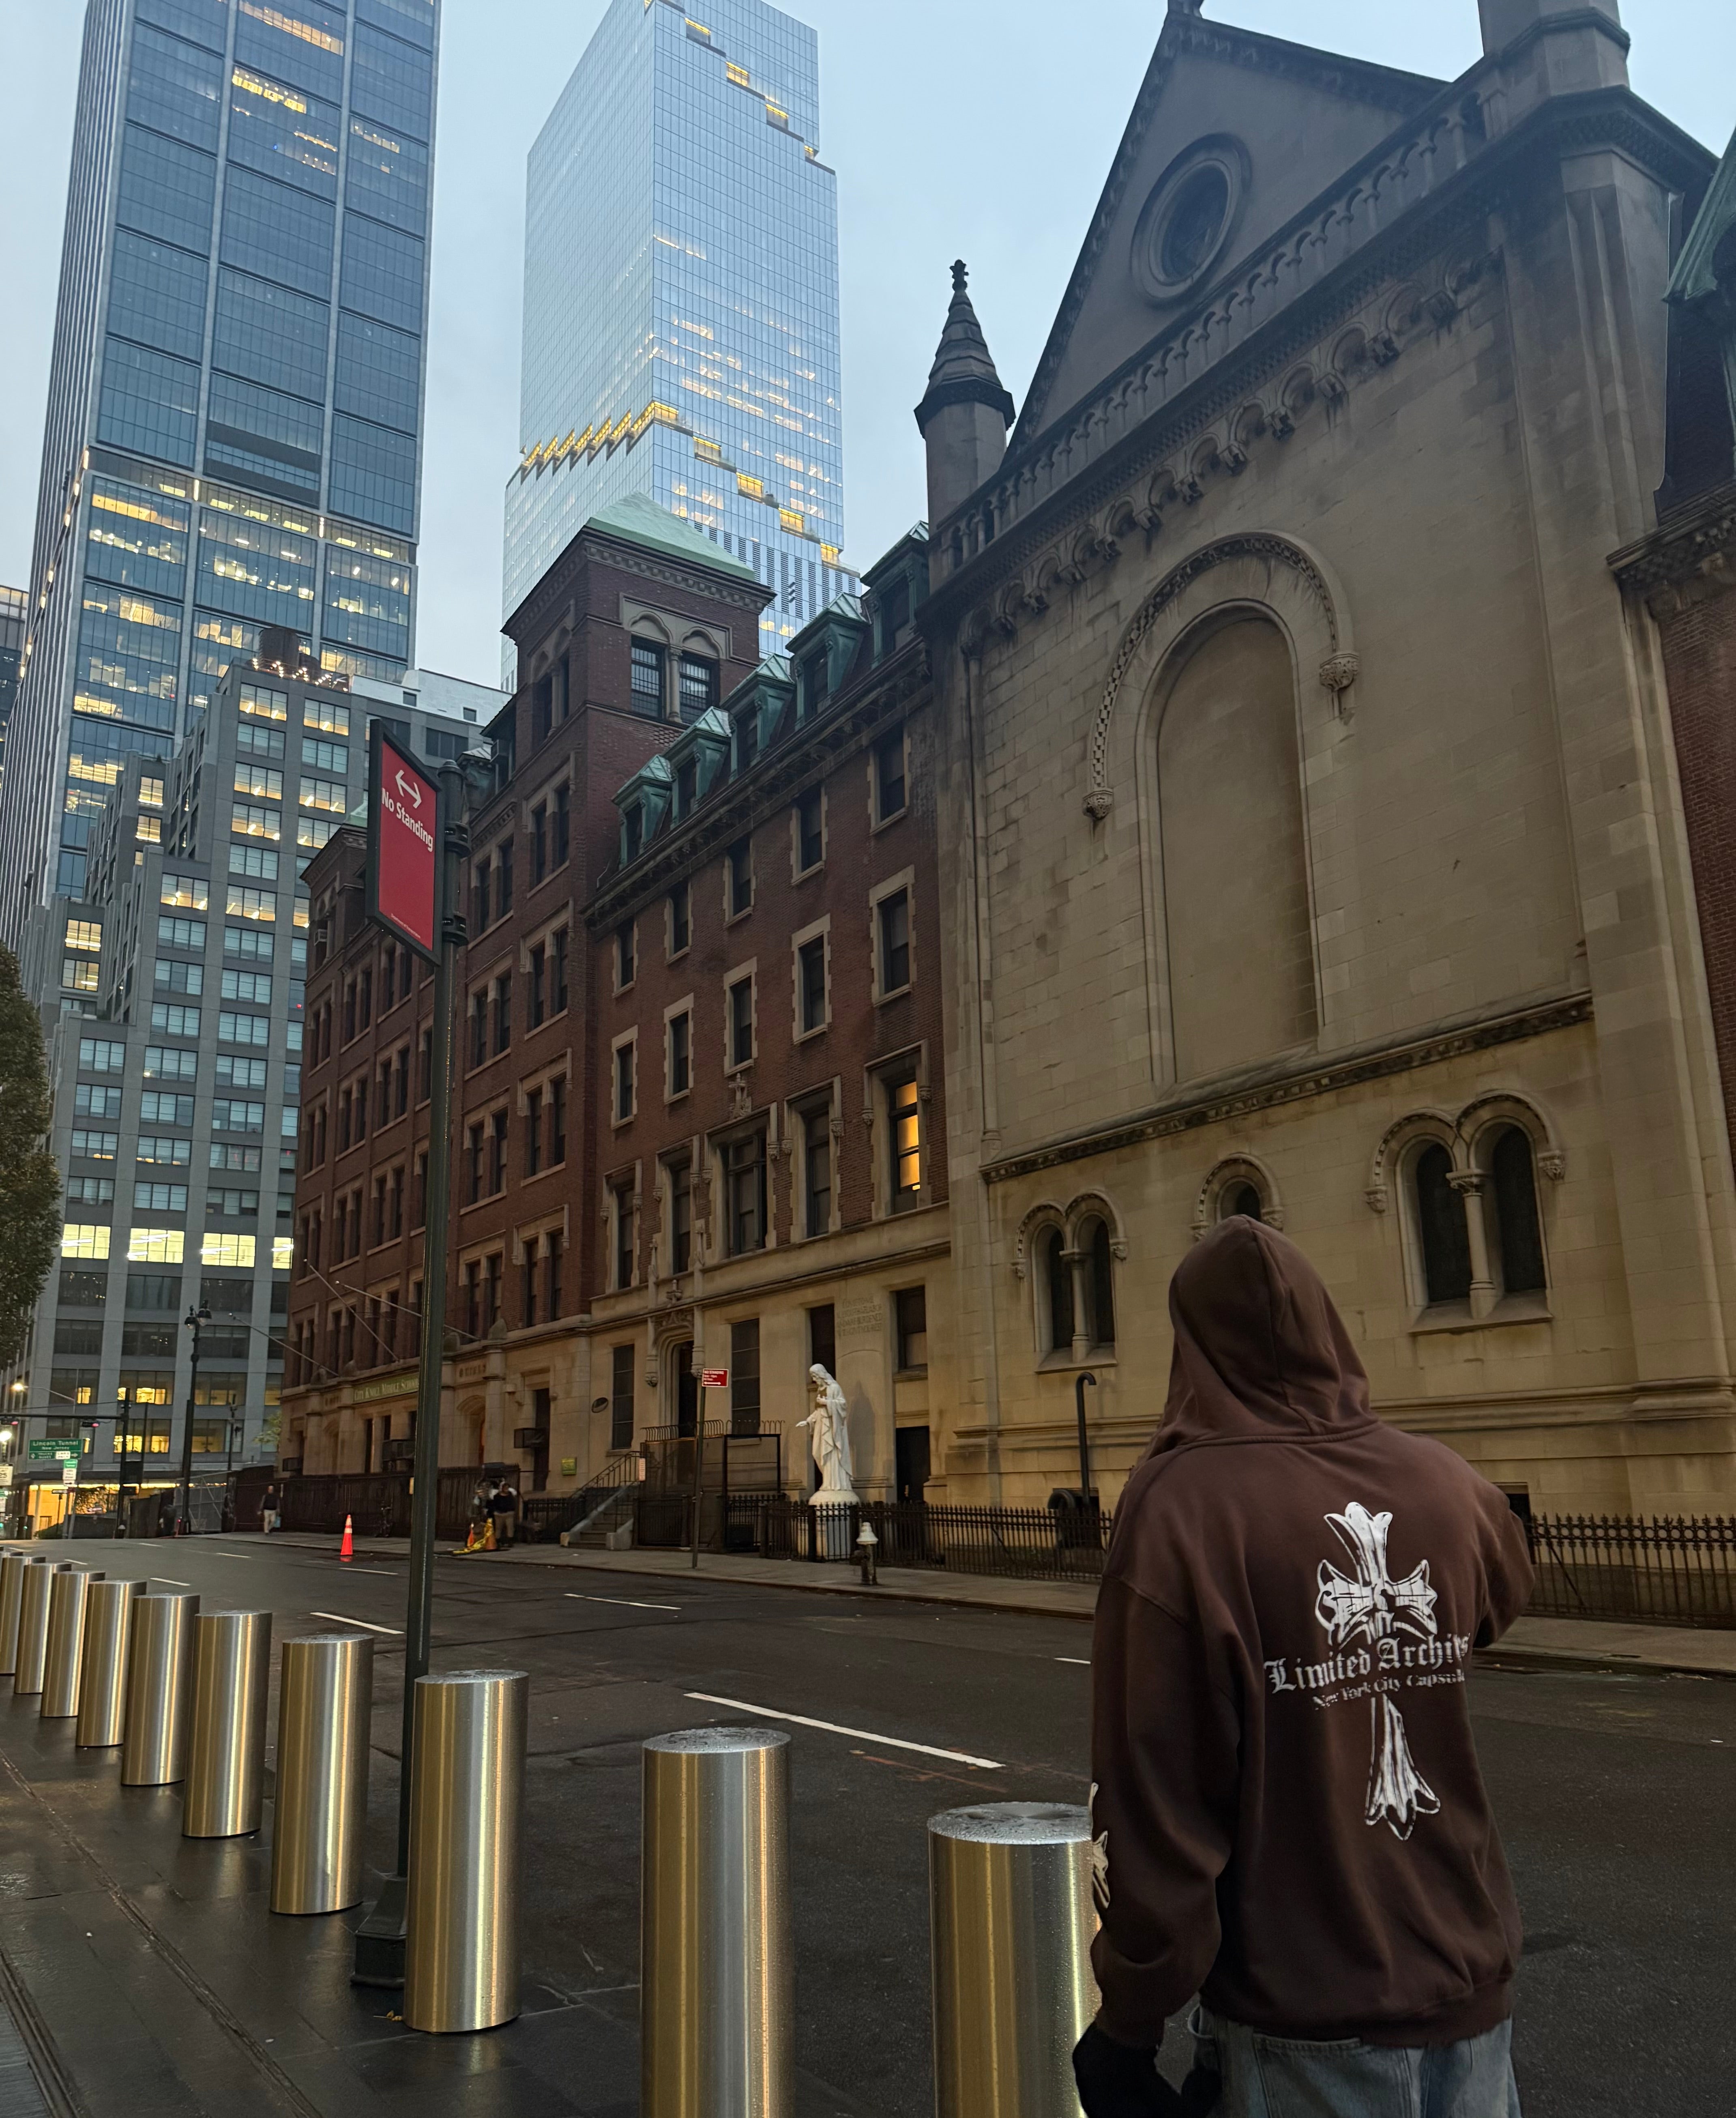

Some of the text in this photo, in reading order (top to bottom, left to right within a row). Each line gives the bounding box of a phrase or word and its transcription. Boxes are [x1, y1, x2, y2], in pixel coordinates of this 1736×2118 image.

[381, 788, 433, 852] No Standing
[402, 1378, 419, 1392] SCHOO
[1263, 1648, 1371, 1694] Limited
